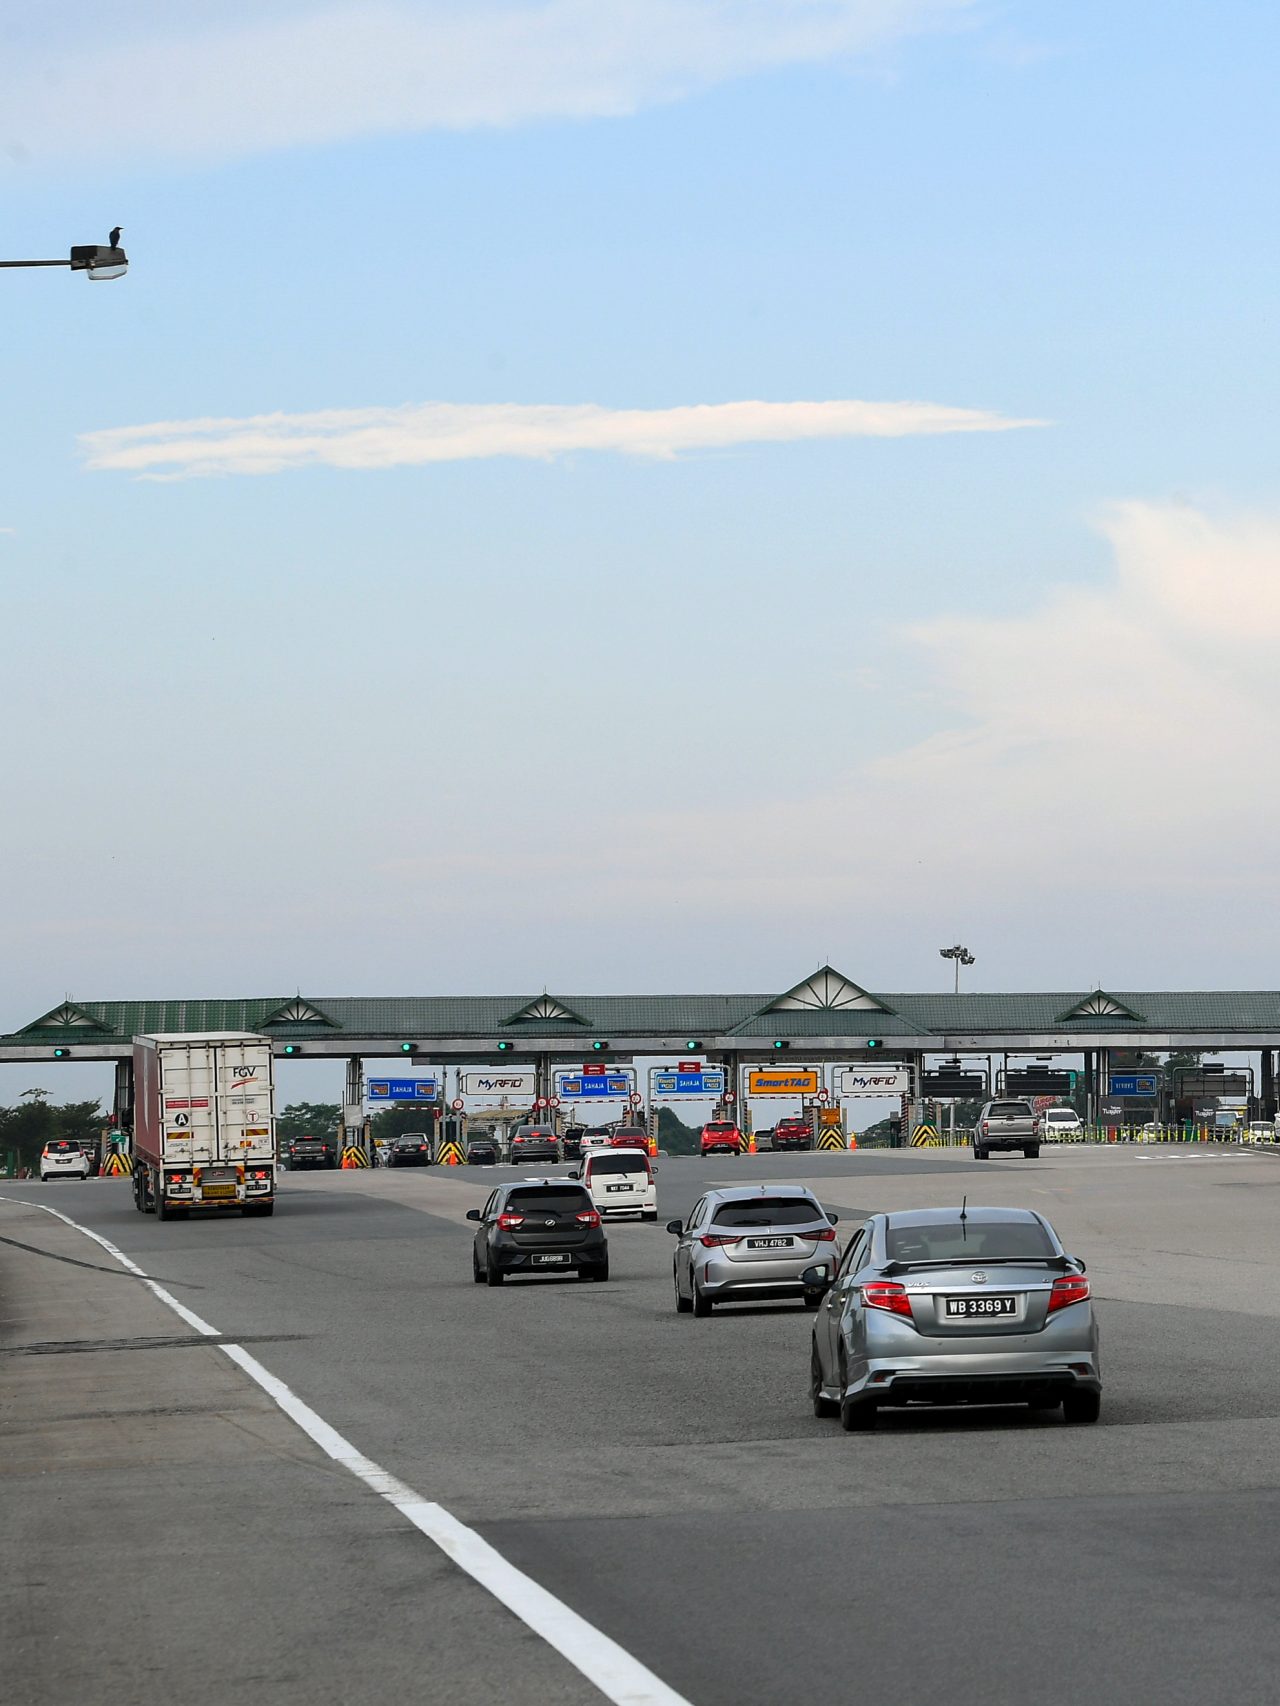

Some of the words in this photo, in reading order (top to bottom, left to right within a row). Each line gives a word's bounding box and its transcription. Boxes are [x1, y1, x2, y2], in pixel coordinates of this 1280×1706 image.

[233, 1067, 256, 1078] FGV
[584, 1082, 605, 1090] SAHAJA
[769, 1239, 787, 1247] 4782
[950, 1302, 967, 1314] WB
[969, 1300, 1001, 1313] 3369
[1004, 1300, 1012, 1311] Y
